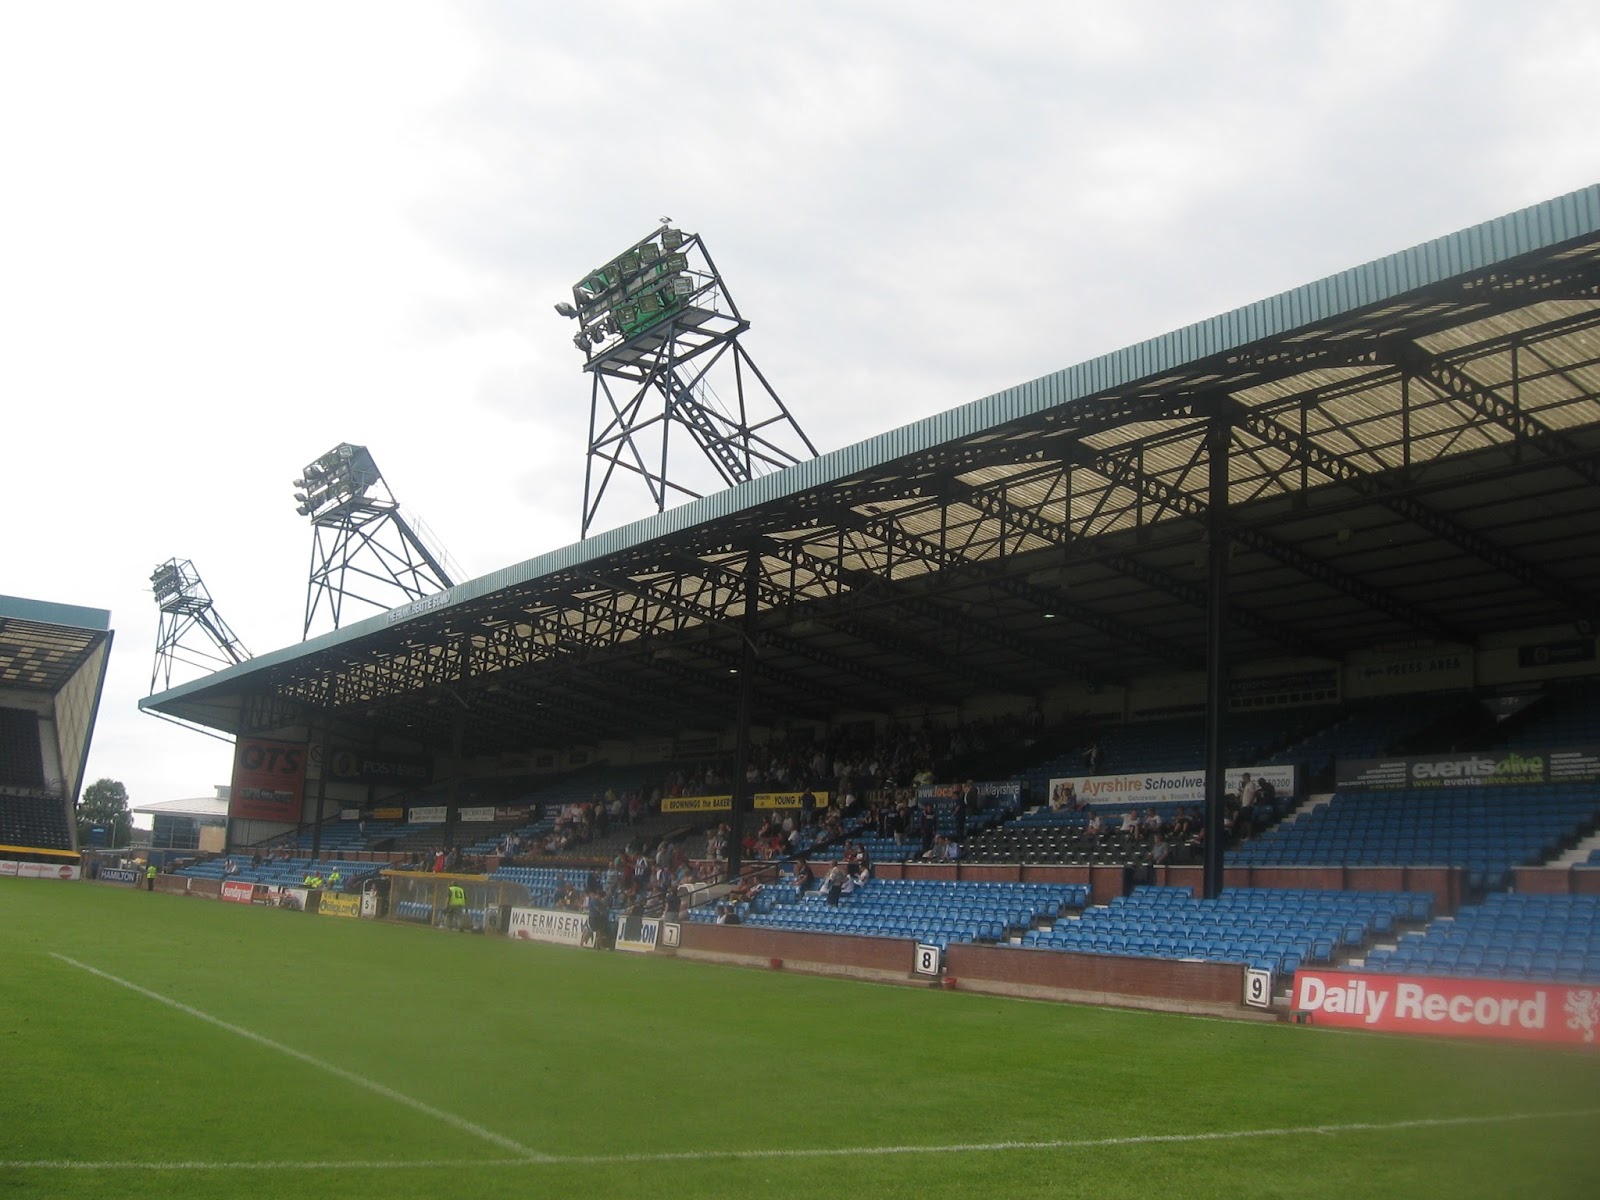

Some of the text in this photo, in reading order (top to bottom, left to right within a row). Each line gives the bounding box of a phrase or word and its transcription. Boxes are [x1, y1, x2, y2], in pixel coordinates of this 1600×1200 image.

[241, 745, 301, 774] OTS
[1081, 777, 1142, 796] Ayrshire
[669, 799, 701, 809] BROWNINGS
[703, 799, 711, 807] the
[774, 795, 796, 805] YOUNG
[101, 869, 134, 881] HAMILTON
[512, 911, 579, 933] WATERMISER
[669, 929, 674, 942] 7
[922, 952, 931, 969] 8
[1251, 977, 1262, 999] 9
[1298, 977, 1547, 1029] Daily Record
